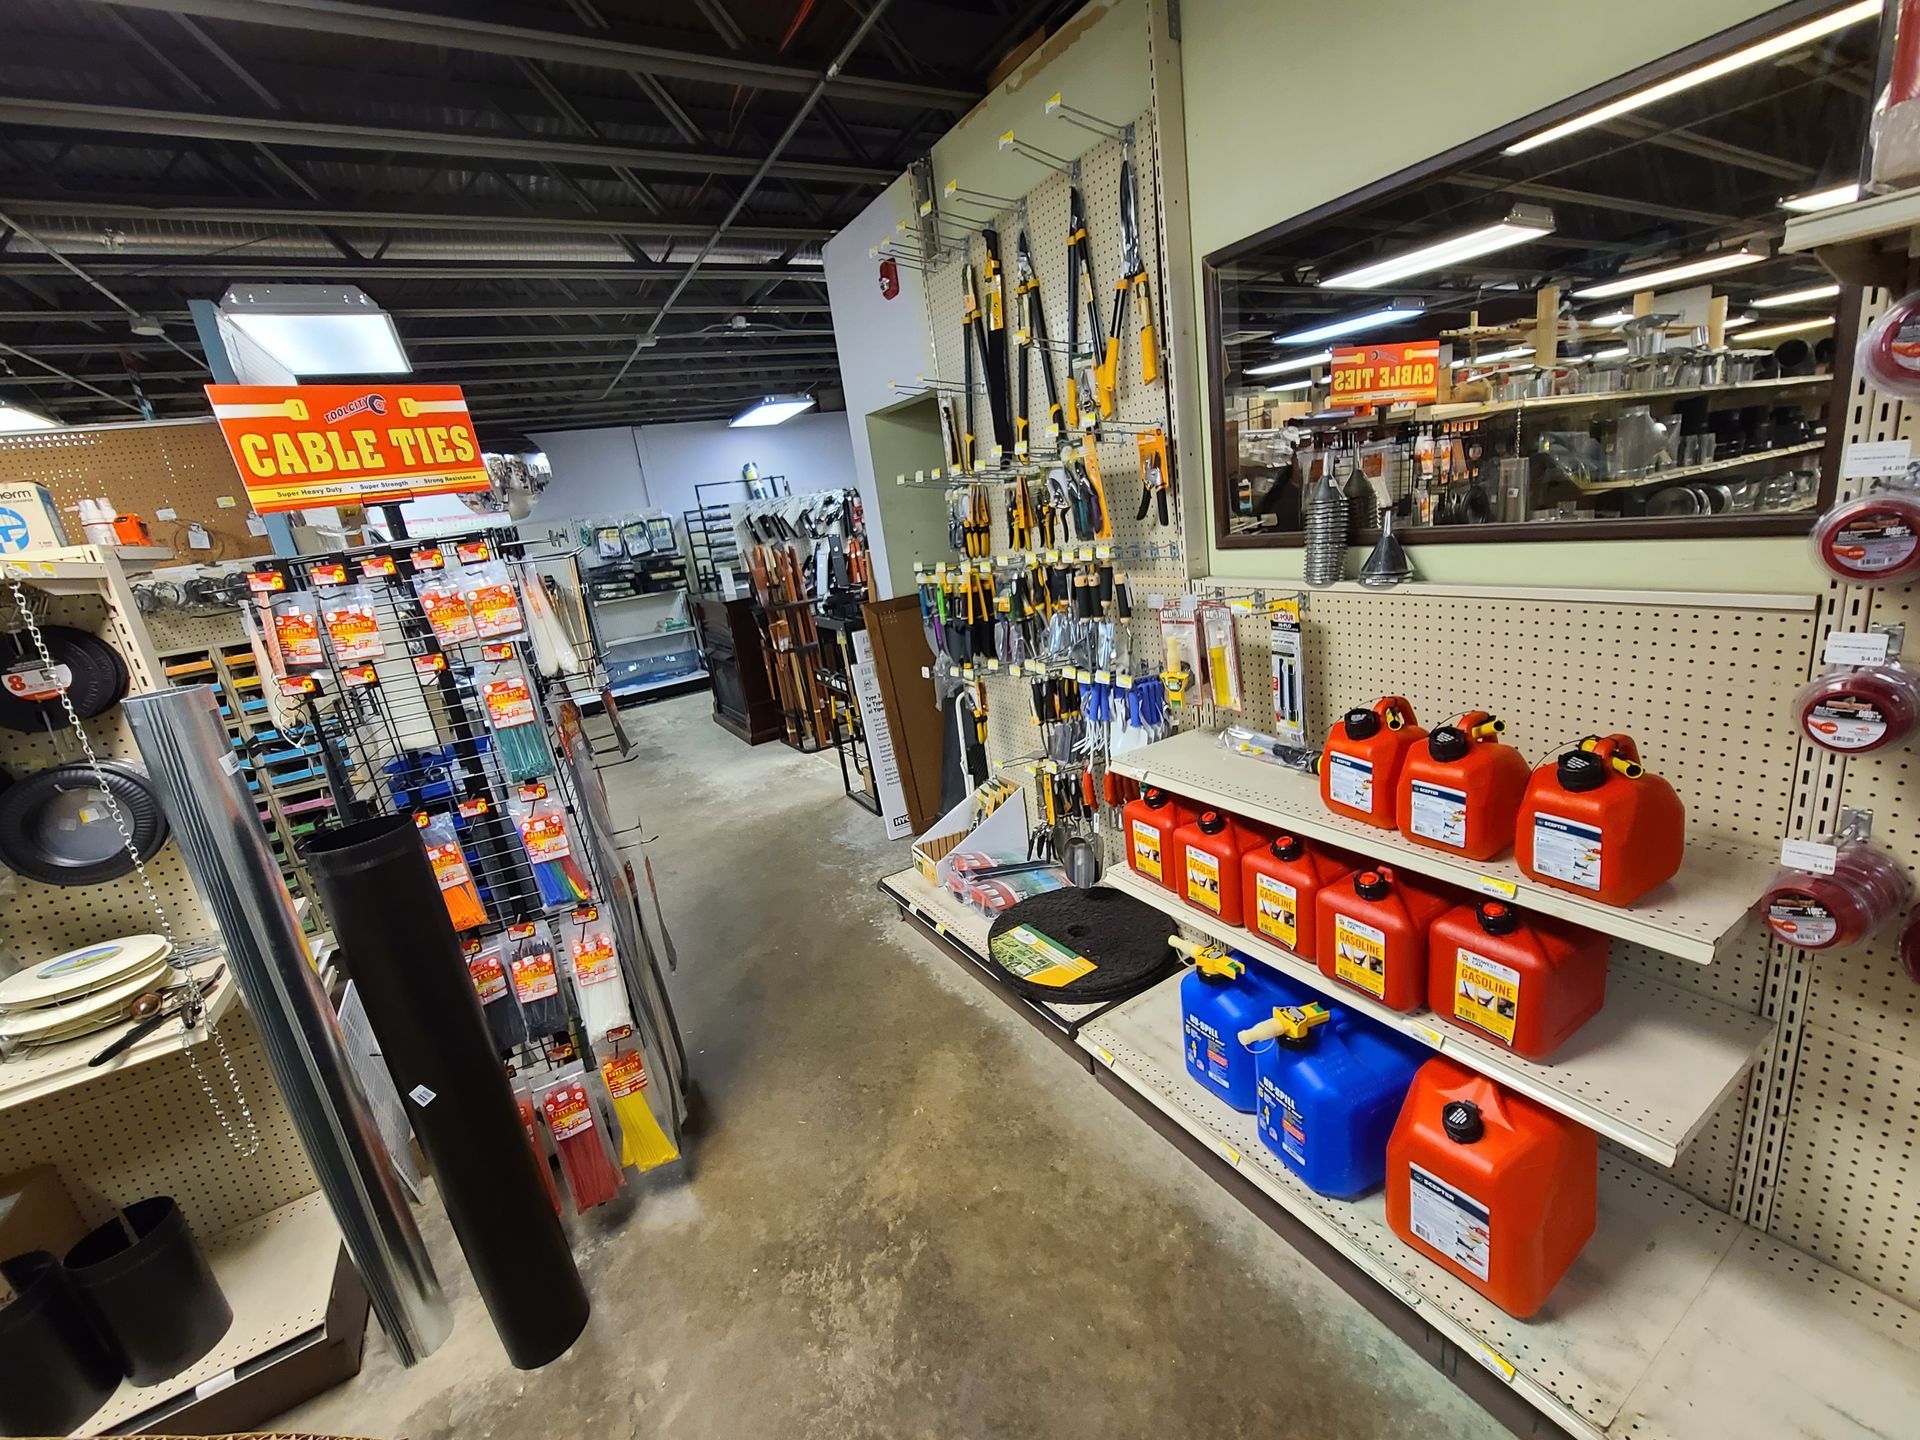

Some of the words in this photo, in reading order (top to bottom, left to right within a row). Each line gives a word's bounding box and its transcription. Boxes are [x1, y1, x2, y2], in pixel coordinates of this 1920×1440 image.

[239, 429, 386, 478] CABLE
[388, 425, 476, 466] TIES
[359, 482, 380, 490] Super
[381, 479, 409, 488] Strength
[423, 476, 443, 485] Strong
[444, 474, 477, 483] Resistance
[0, 490, 32, 500] erm
[276, 490, 299, 498] Super
[301, 488, 325, 497] Heavy
[325, 485, 343, 495] Duty
[1420, 787, 1439, 796] SCEPTER
[1544, 821, 1568, 831] SCEPTER
[1189, 860, 1217, 878] GASOLINE
[1260, 887, 1293, 911] GASOLINE
[1339, 931, 1381, 958] GASOLINE
[1472, 956, 1497, 969] MIDWEST
[1461, 968, 1513, 999] GASOLINE
[1263, 1075, 1296, 1110] NO-SPILL
[1423, 1179, 1455, 1201] SCEPTER
